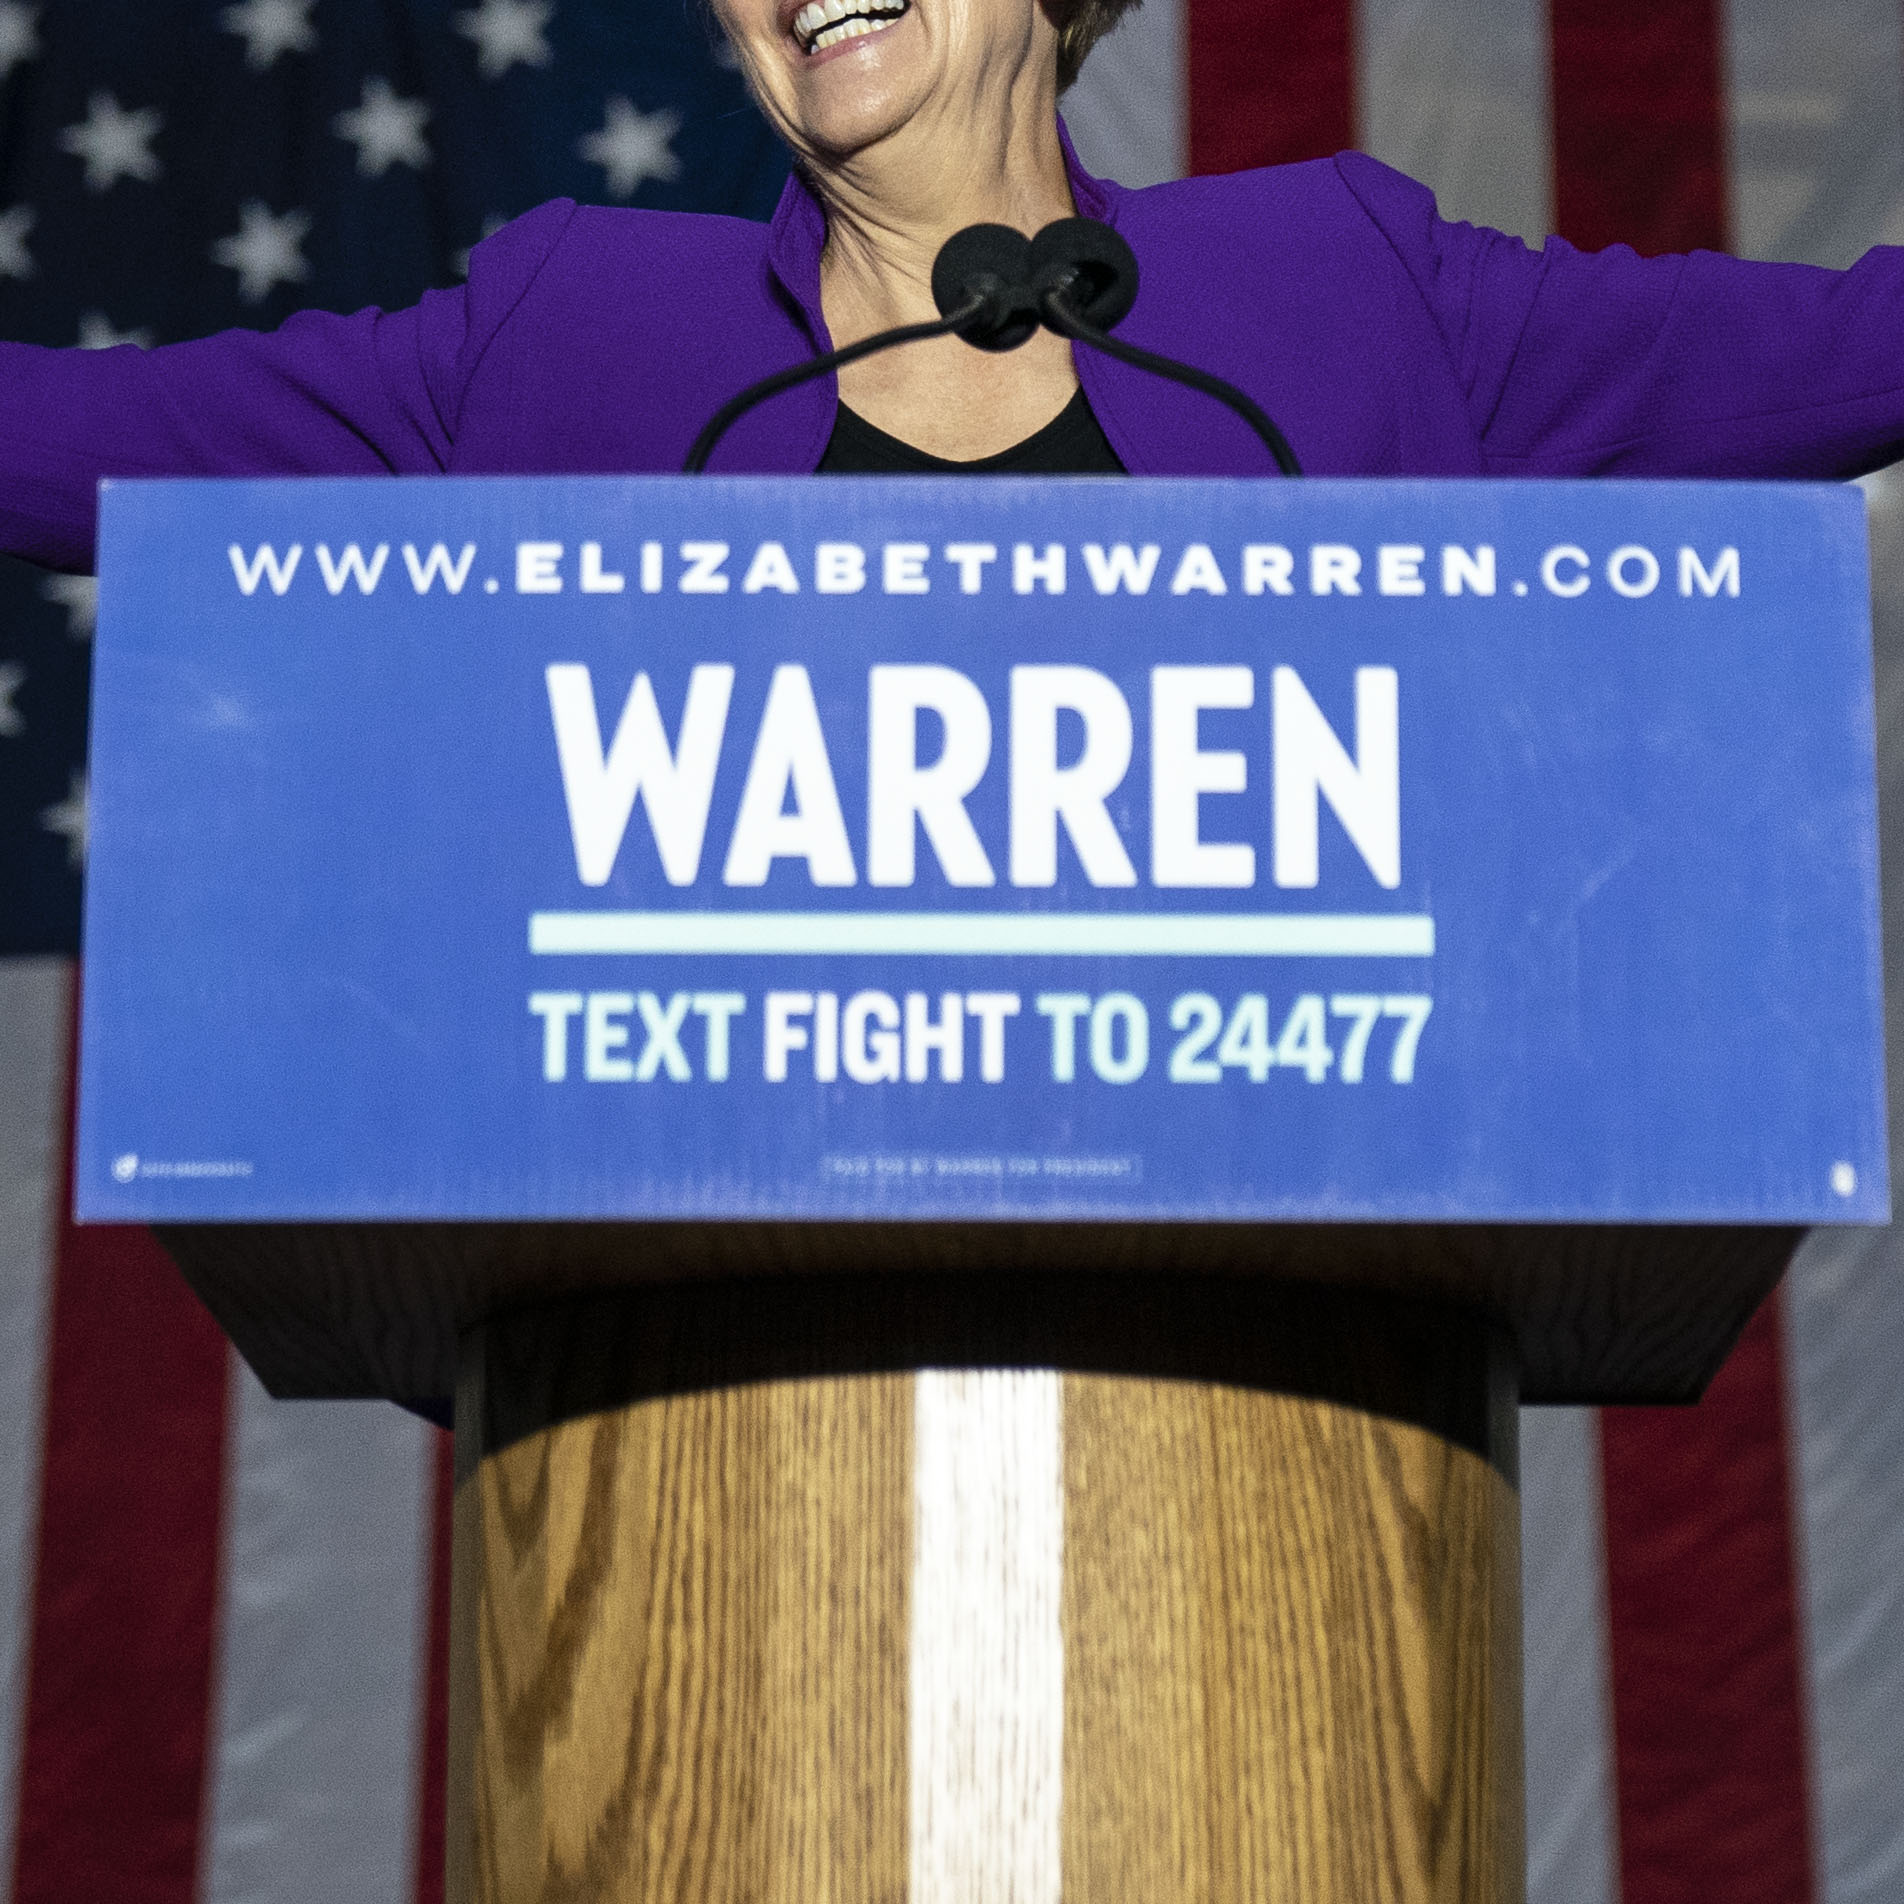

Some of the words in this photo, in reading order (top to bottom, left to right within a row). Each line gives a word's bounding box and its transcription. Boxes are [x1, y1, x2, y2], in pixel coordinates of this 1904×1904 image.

[228, 541, 1742, 598] WWW.ELIZABETHWARREN.COM
[545, 662, 1402, 890] WARREN
[529, 991, 746, 1083] TEXT
[763, 990, 1022, 1084] FIGHT
[1036, 992, 1149, 1083] TO
[1168, 992, 1434, 1084] 24477
